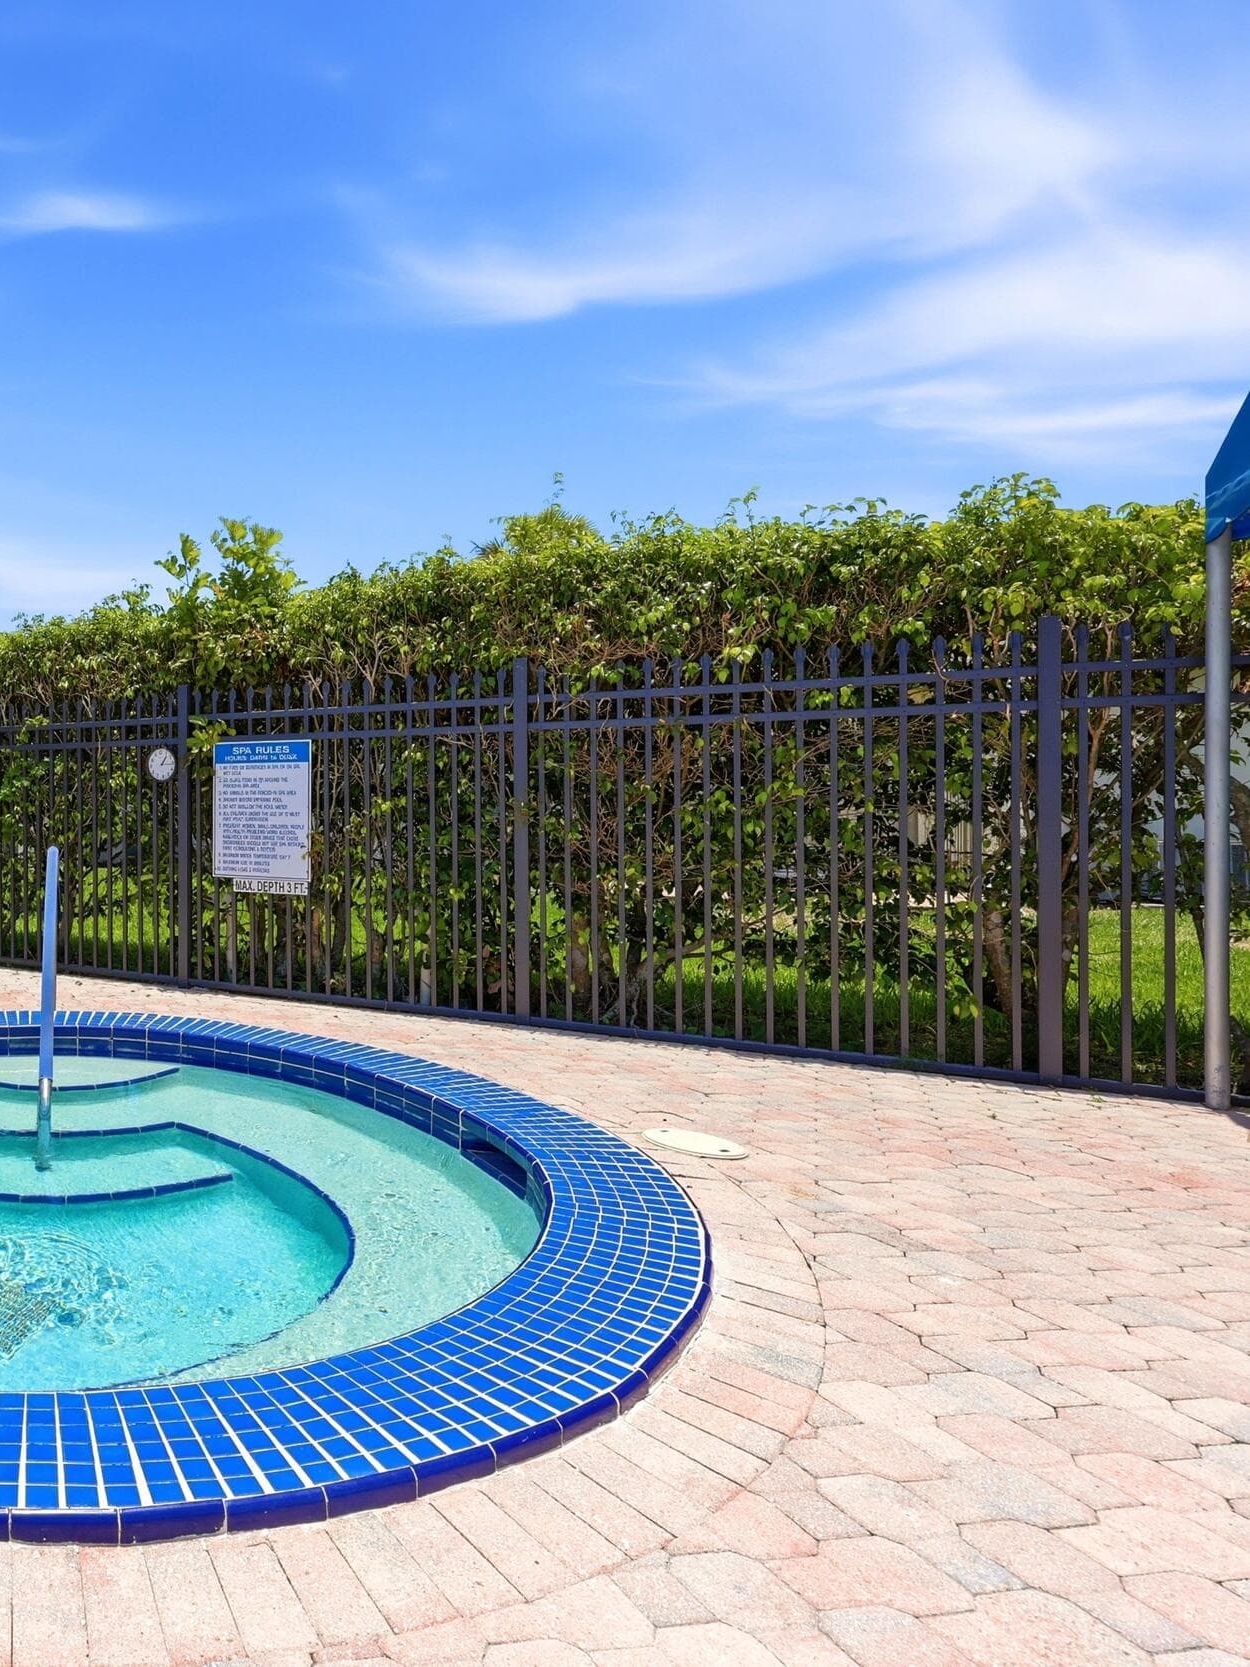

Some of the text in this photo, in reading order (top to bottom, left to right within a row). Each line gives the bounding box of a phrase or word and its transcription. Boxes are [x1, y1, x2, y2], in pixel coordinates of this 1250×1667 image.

[232, 745, 290, 755] SPA RULES
[235, 880, 306, 894] MAX. DEPTH 3 FT.
